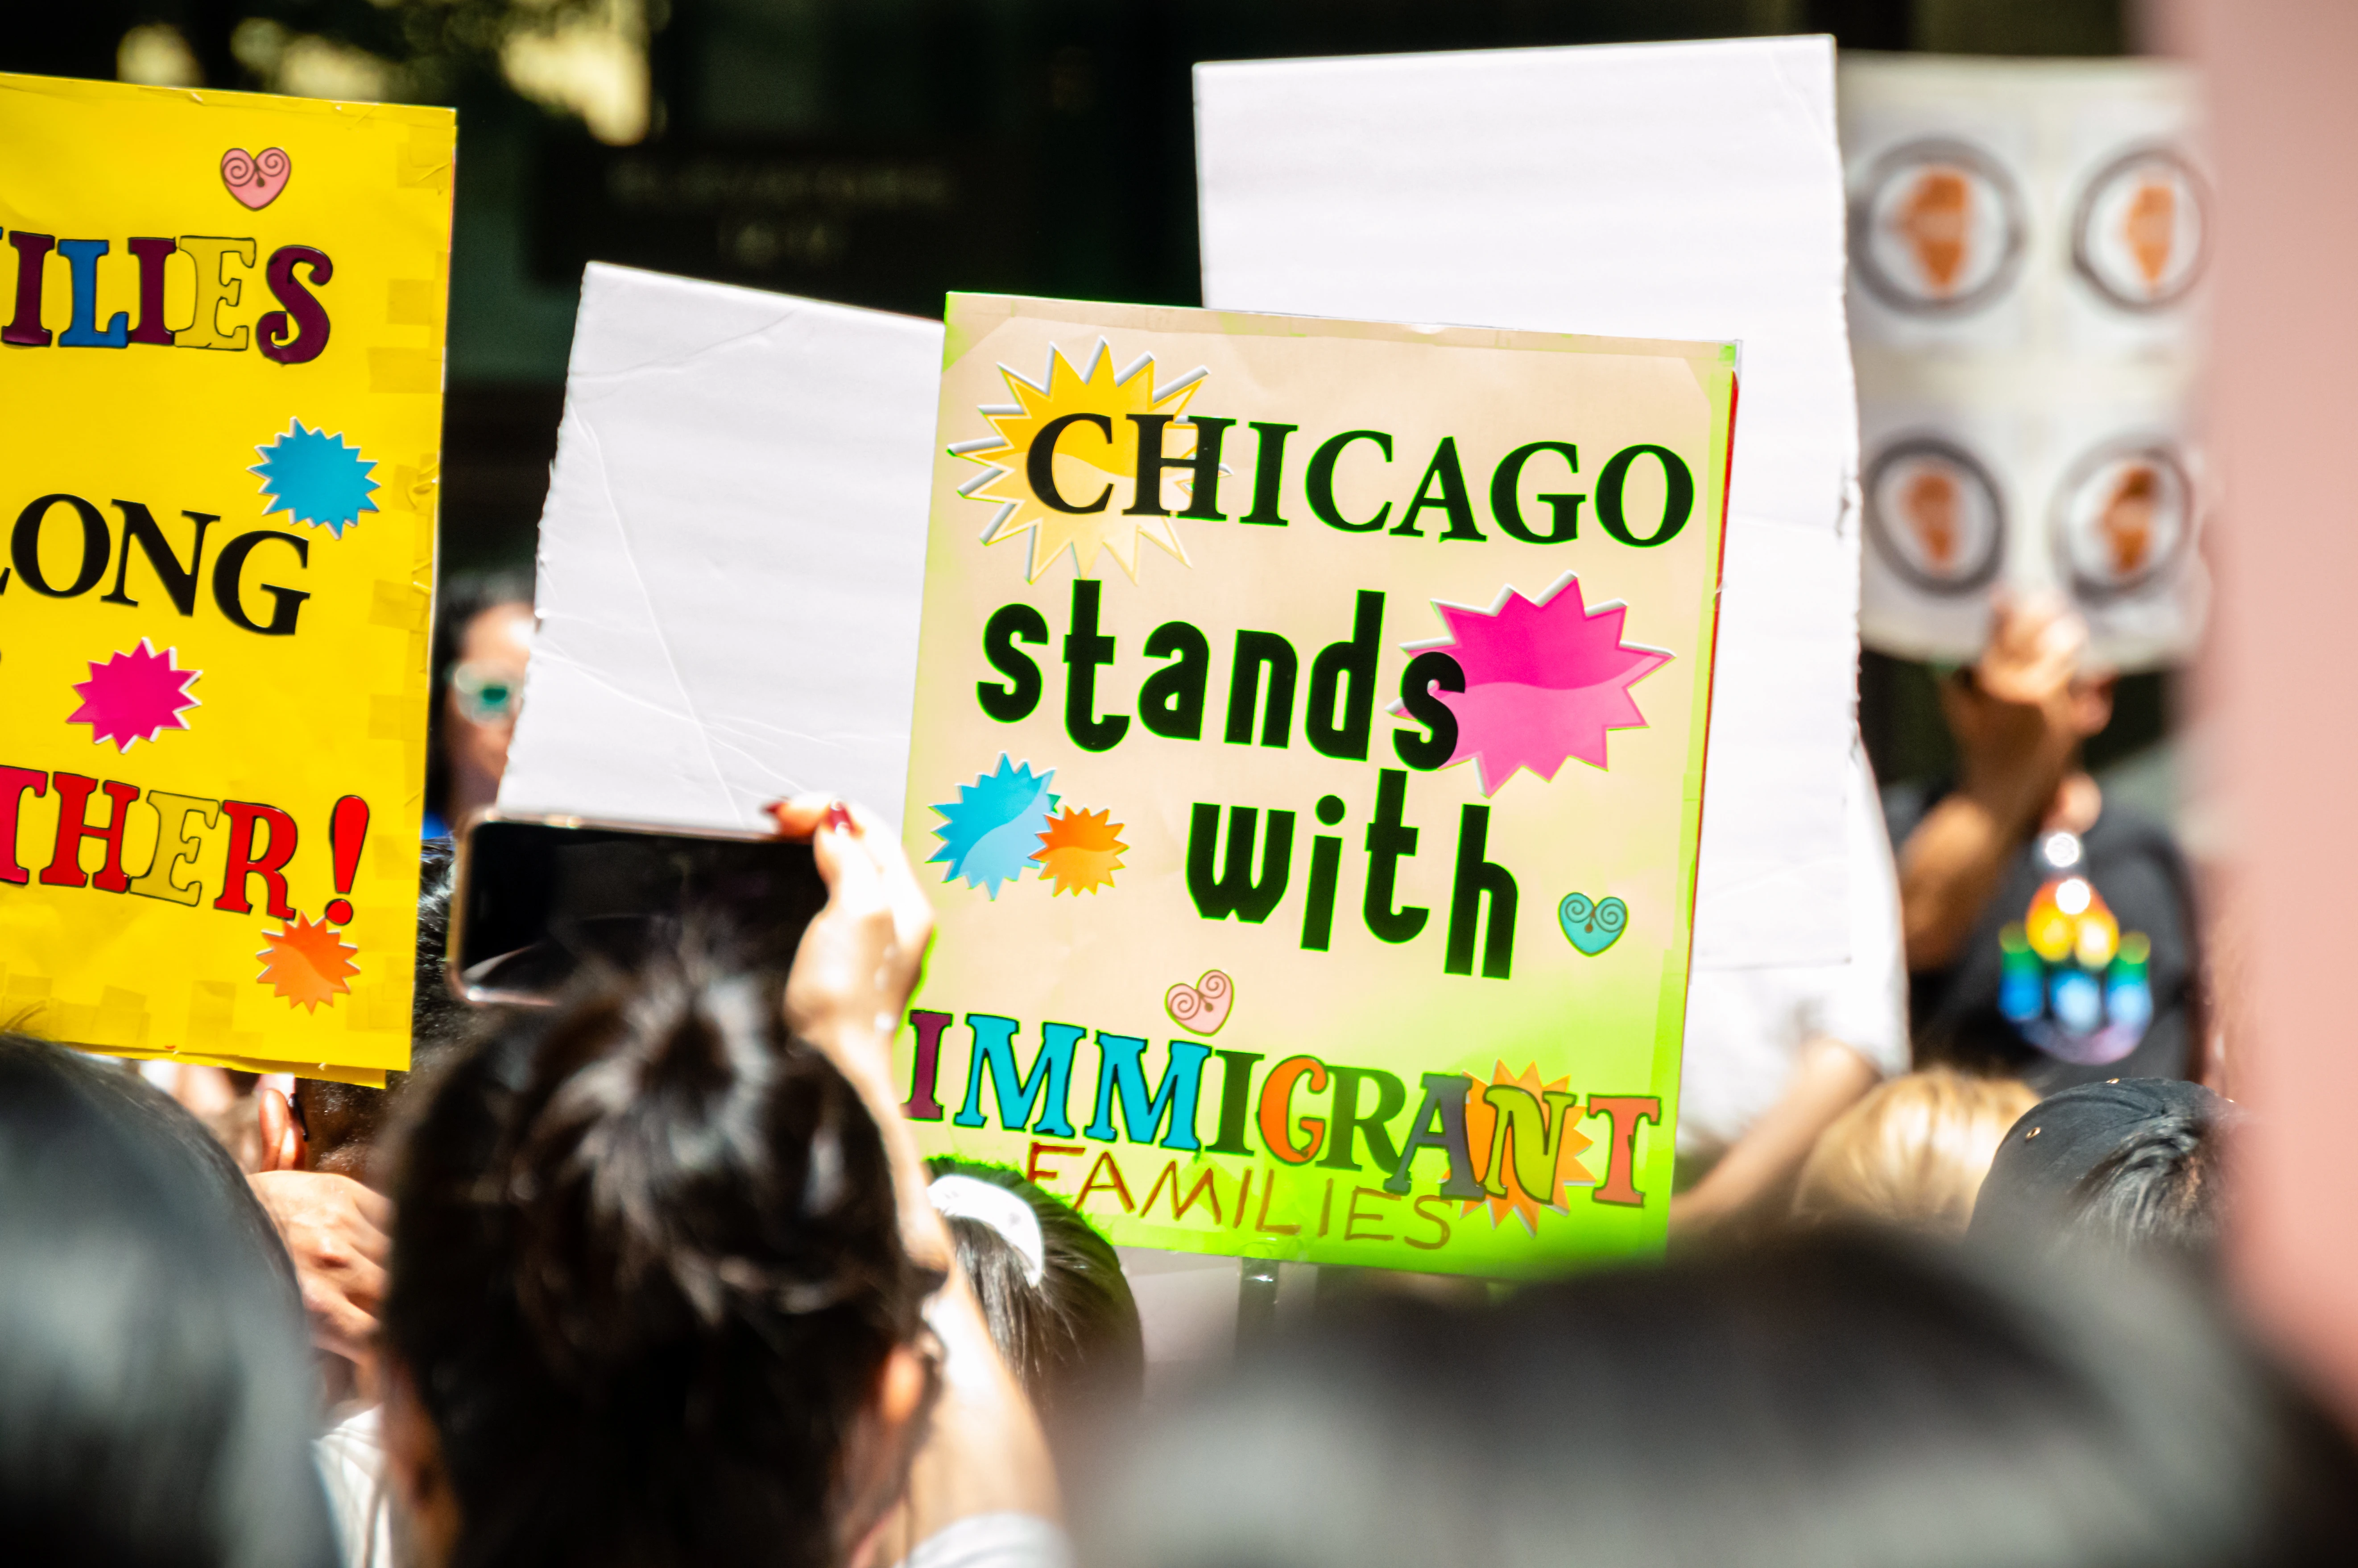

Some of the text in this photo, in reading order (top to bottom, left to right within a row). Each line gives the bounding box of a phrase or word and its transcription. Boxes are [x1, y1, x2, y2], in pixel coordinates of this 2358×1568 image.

[0, 227, 333, 364] ILIES
[1026, 413, 1694, 547] CHICAGO
[976, 579, 1466, 771] stands
[1185, 768, 1518, 980] with
[901, 1009, 1661, 1208] IMMIGRANT
[1027, 1142, 1452, 1249] FAMILIES
